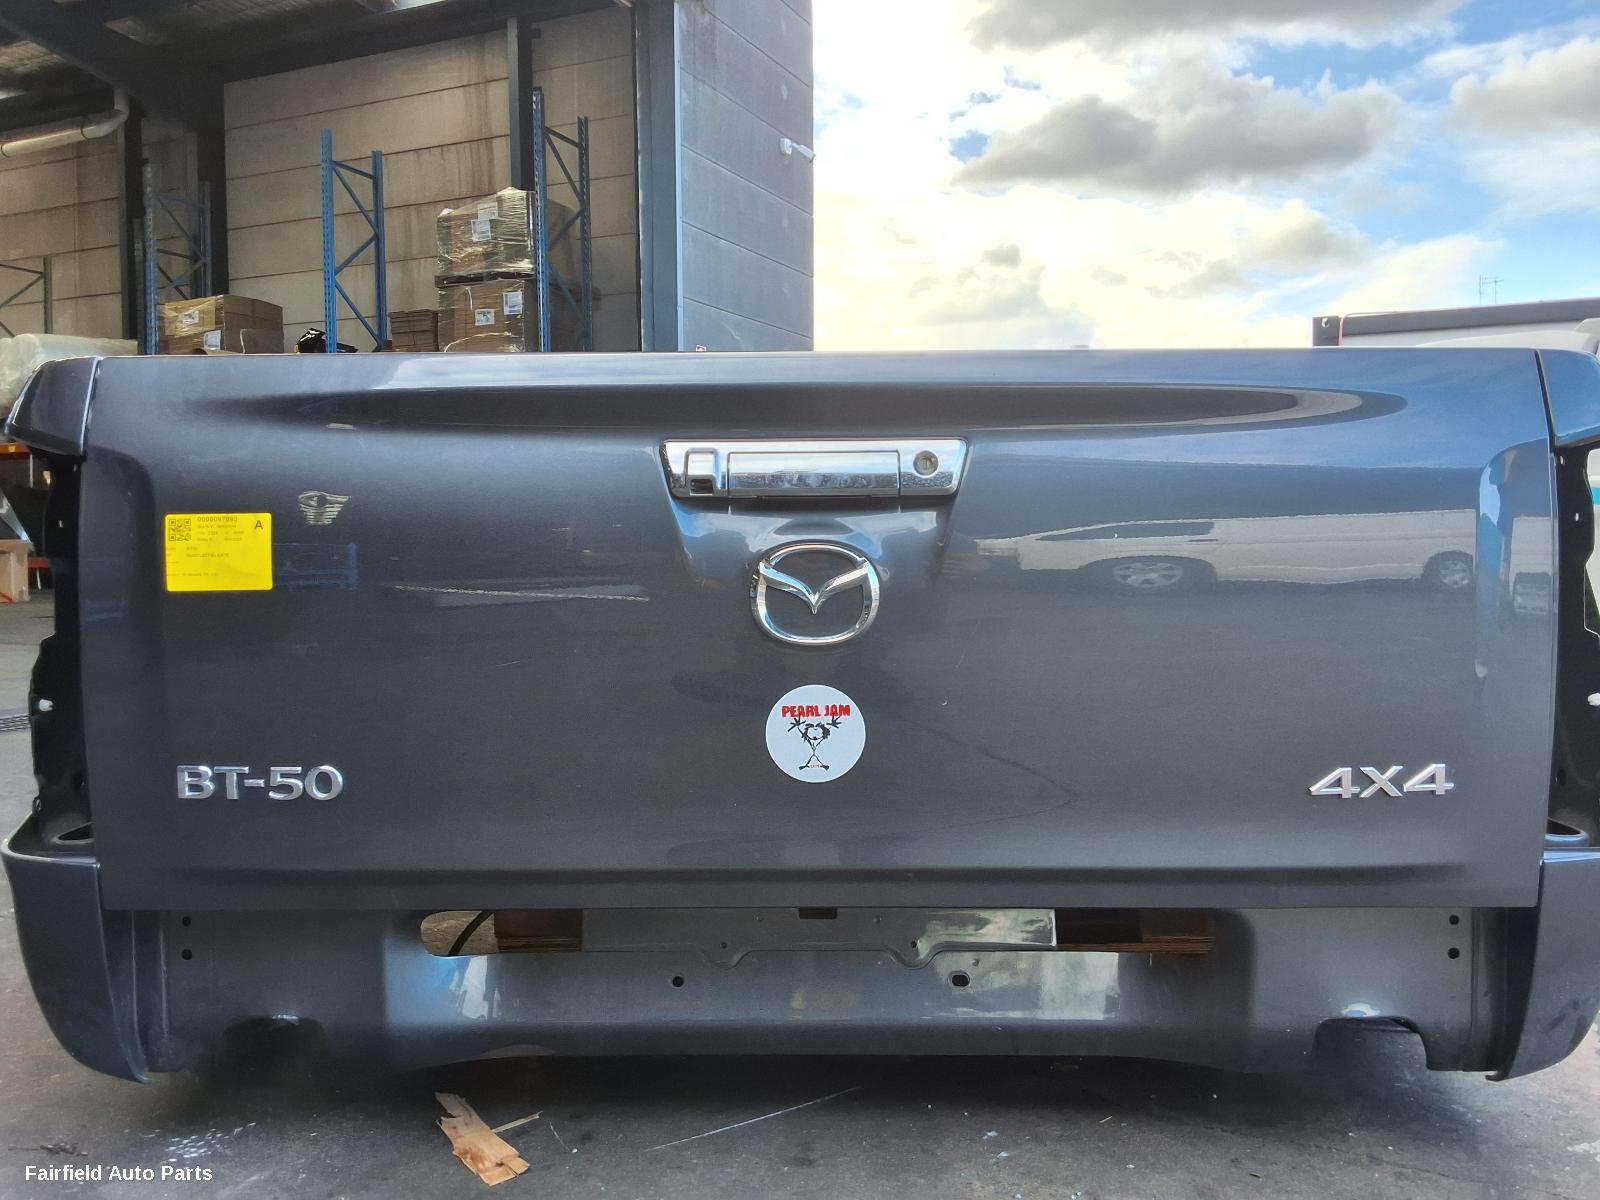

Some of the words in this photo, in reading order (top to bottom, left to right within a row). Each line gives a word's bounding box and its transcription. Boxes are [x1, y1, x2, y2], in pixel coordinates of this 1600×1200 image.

[254, 519, 264, 530] A
[781, 704, 822, 718] PEARL
[824, 703, 851, 717] JAM
[176, 765, 344, 801] BT-50
[1308, 763, 1455, 799] 4X4
